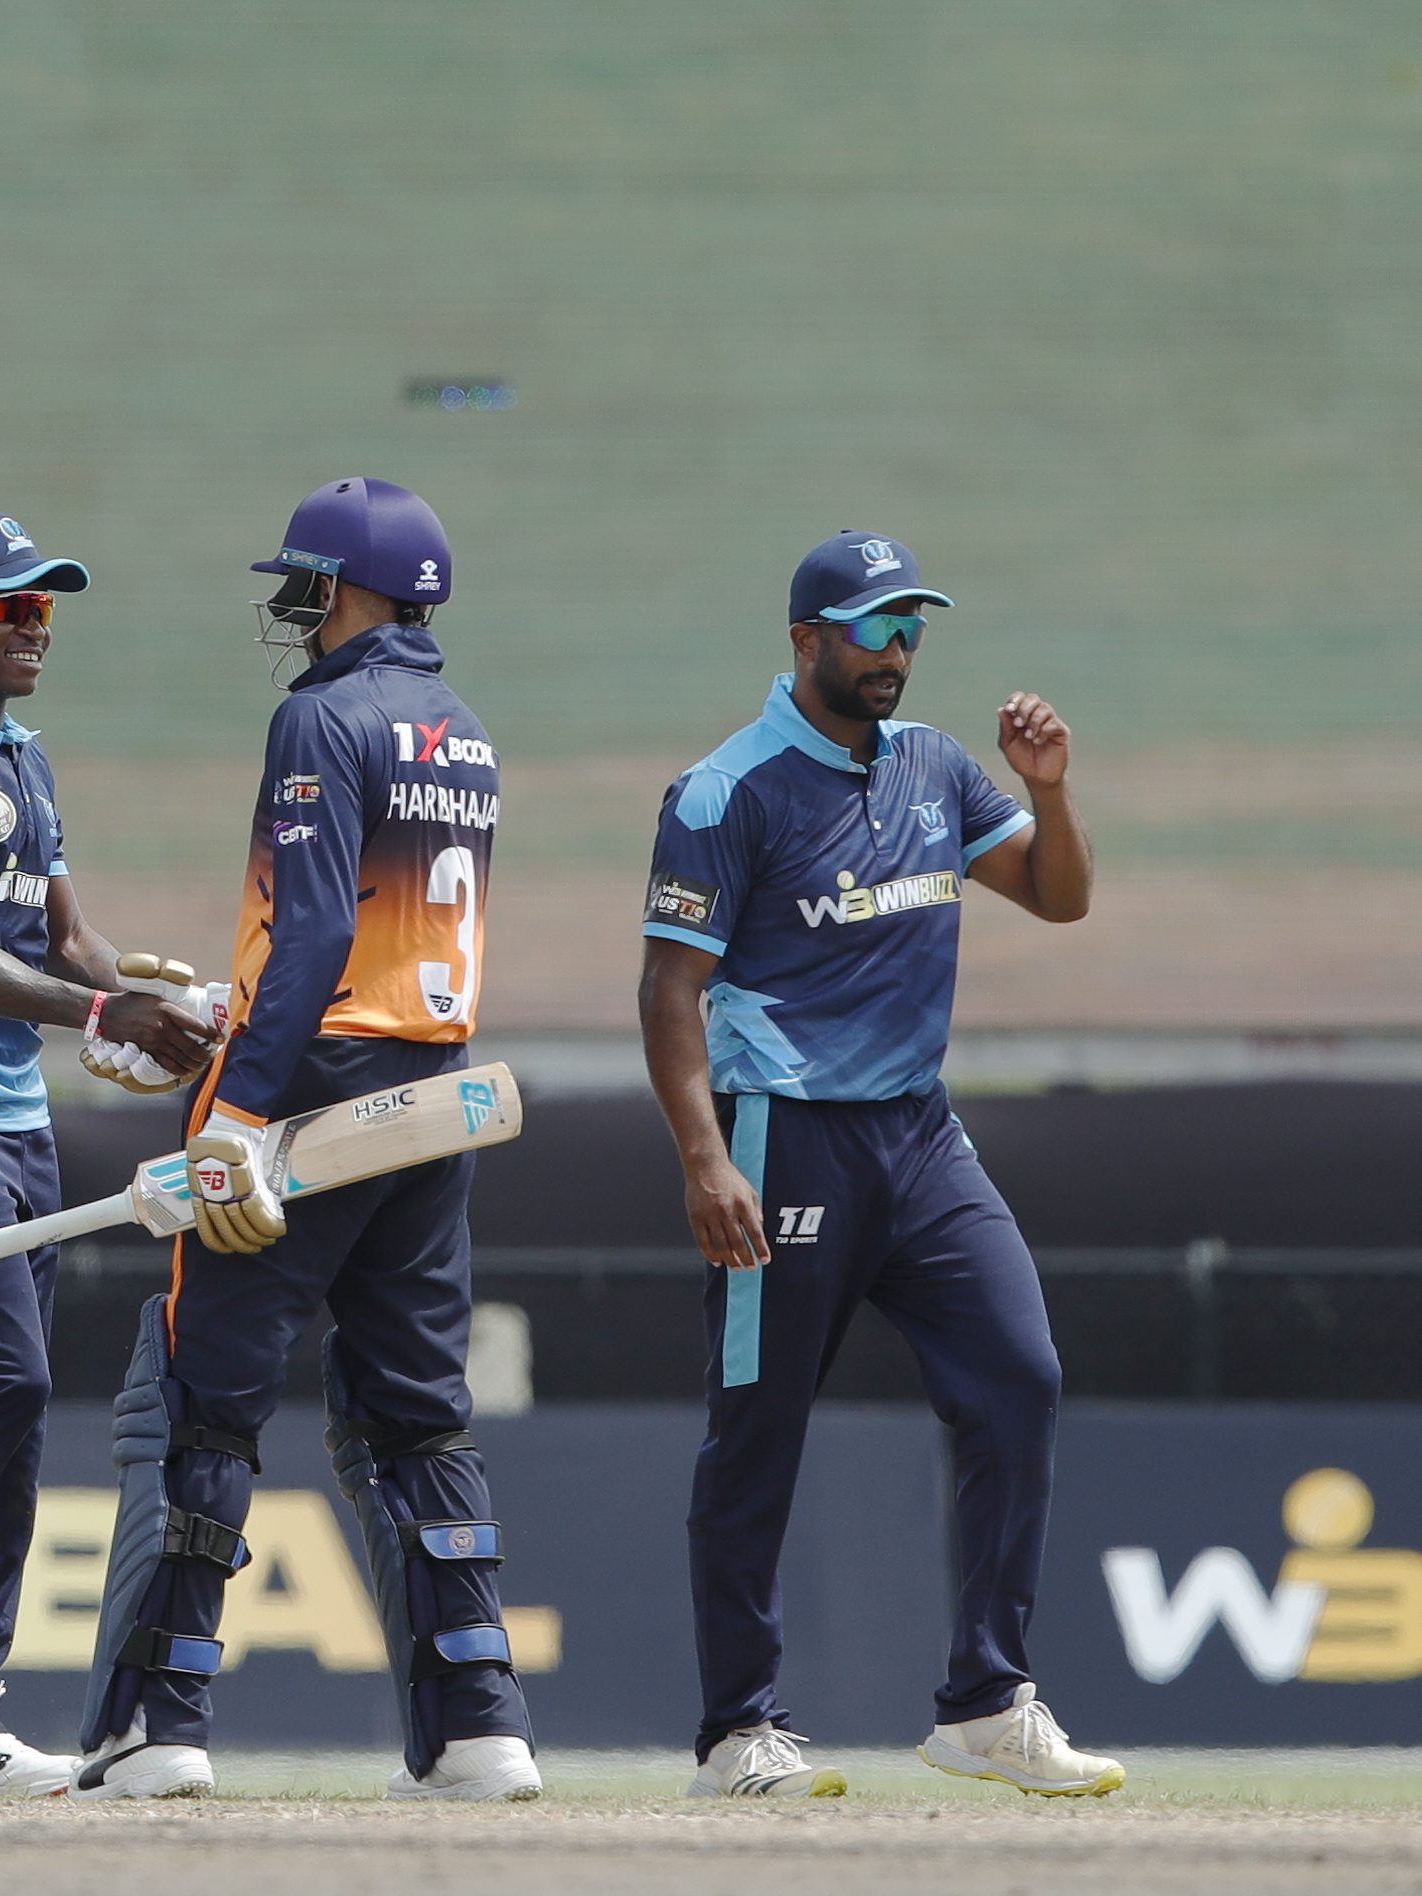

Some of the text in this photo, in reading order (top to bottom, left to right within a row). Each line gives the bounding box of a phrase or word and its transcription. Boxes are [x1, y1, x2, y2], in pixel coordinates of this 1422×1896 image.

[875, 873, 957, 913] WINBUZZ
[418, 845, 476, 1025] 3
[354, 1088, 416, 1121] HSIC
